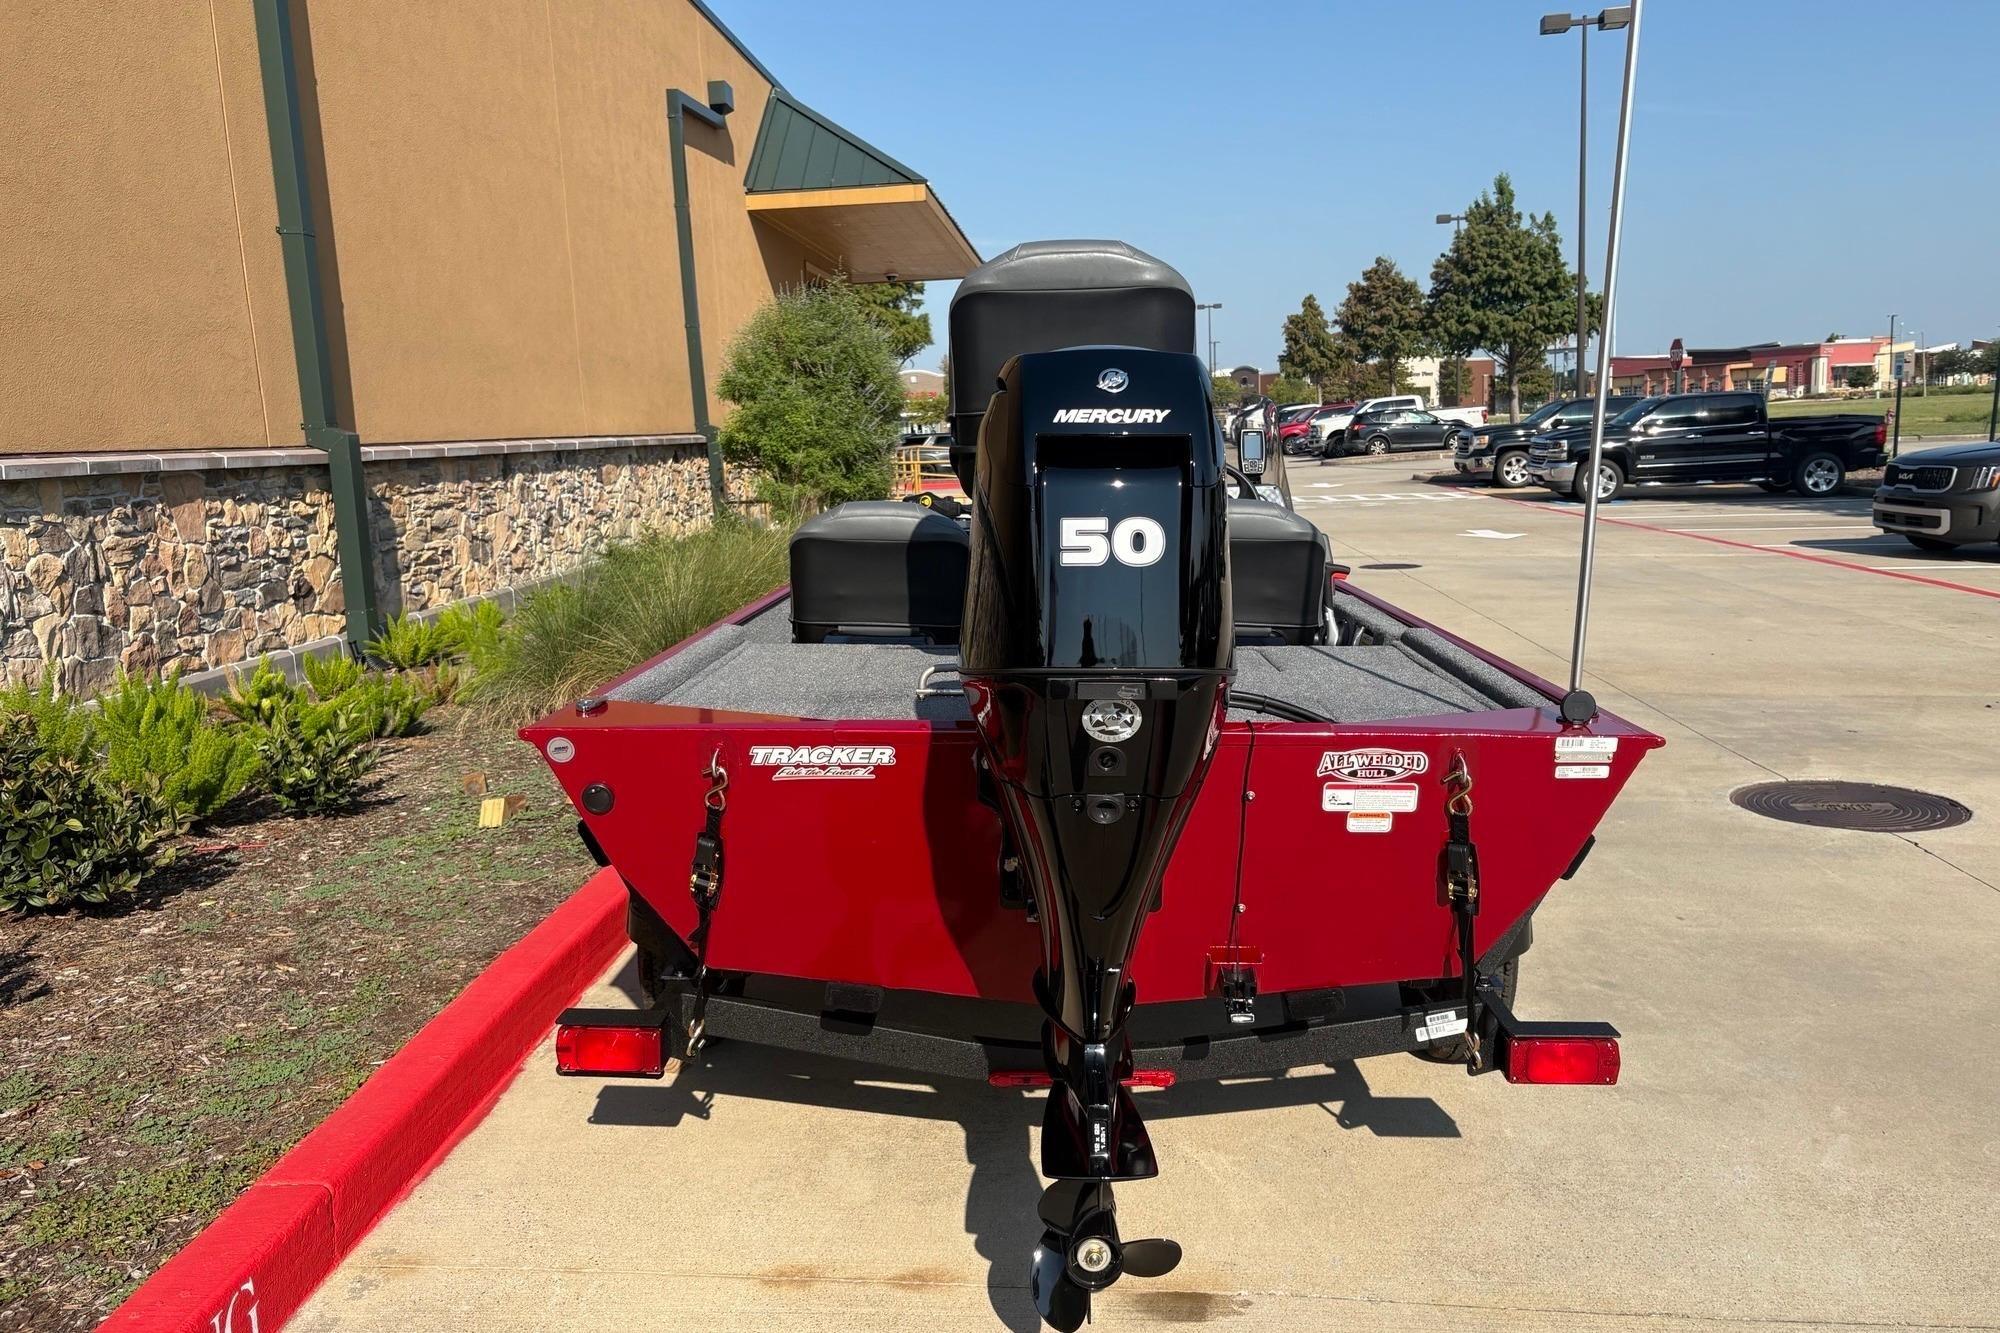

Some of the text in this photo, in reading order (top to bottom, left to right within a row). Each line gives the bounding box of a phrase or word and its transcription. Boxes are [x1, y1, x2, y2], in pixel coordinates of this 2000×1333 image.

[1053, 408, 1171, 424] MERCURY
[1060, 516, 1166, 567] 50
[751, 747, 893, 764] TRACKER
[1319, 753, 1426, 772] ALL WELDED
[778, 767, 802, 776] Fish
[804, 767, 822, 776] the
[1356, 769, 1388, 778] HULL
